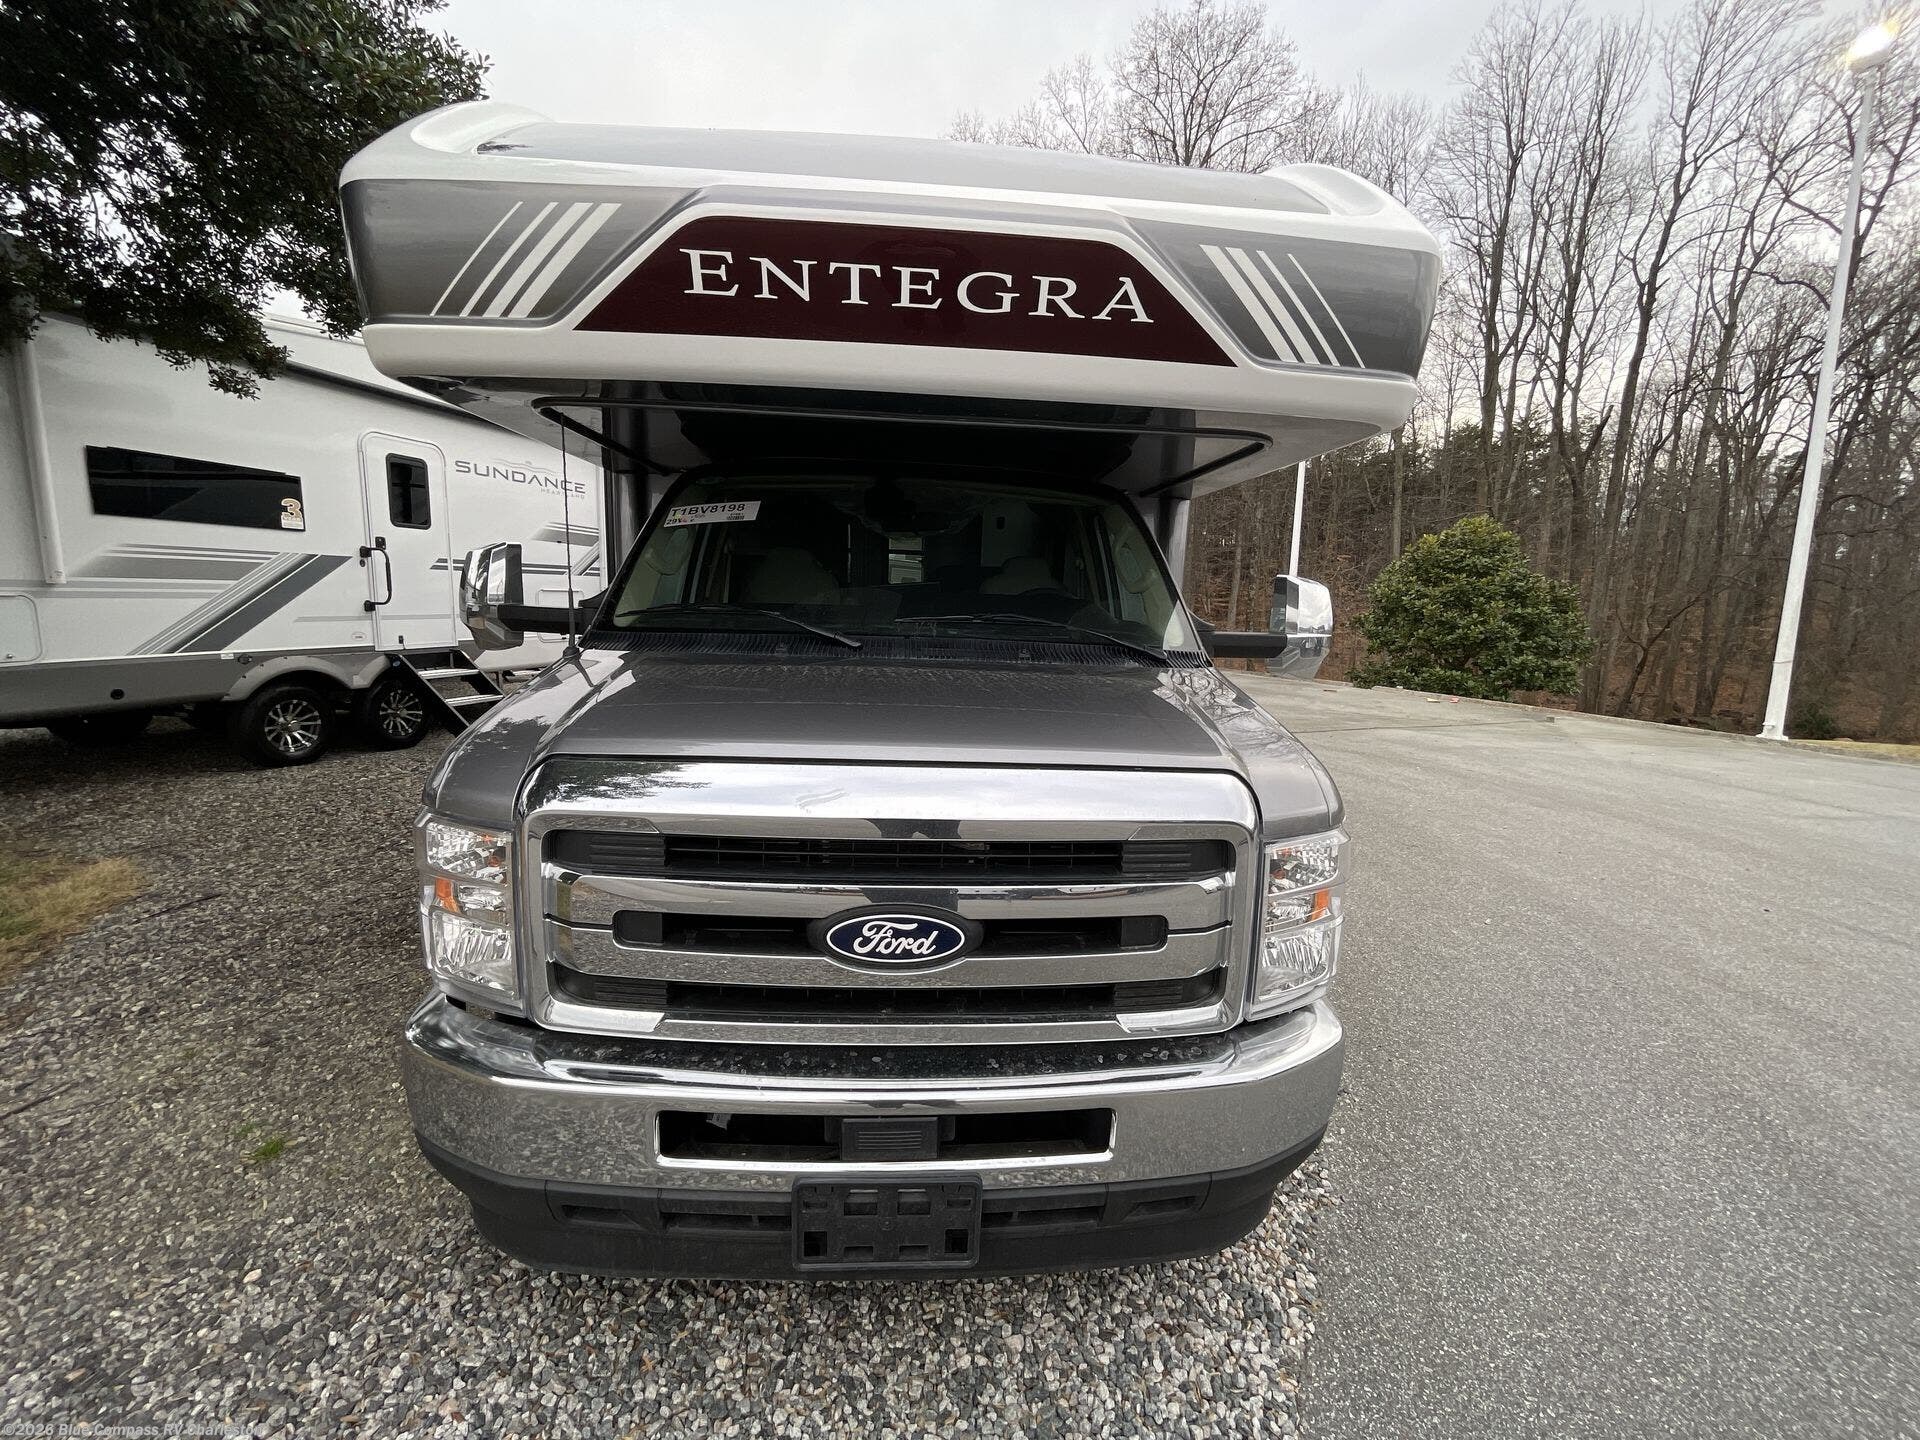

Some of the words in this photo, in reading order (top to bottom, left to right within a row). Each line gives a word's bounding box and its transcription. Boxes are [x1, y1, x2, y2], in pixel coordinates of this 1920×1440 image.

[679, 248, 1154, 324] ENTEGRA
[455, 460, 586, 494] SUNDANCE
[281, 498, 302, 519] 3
[671, 503, 746, 517] T1BV8198
[853, 920, 939, 955] Ford
